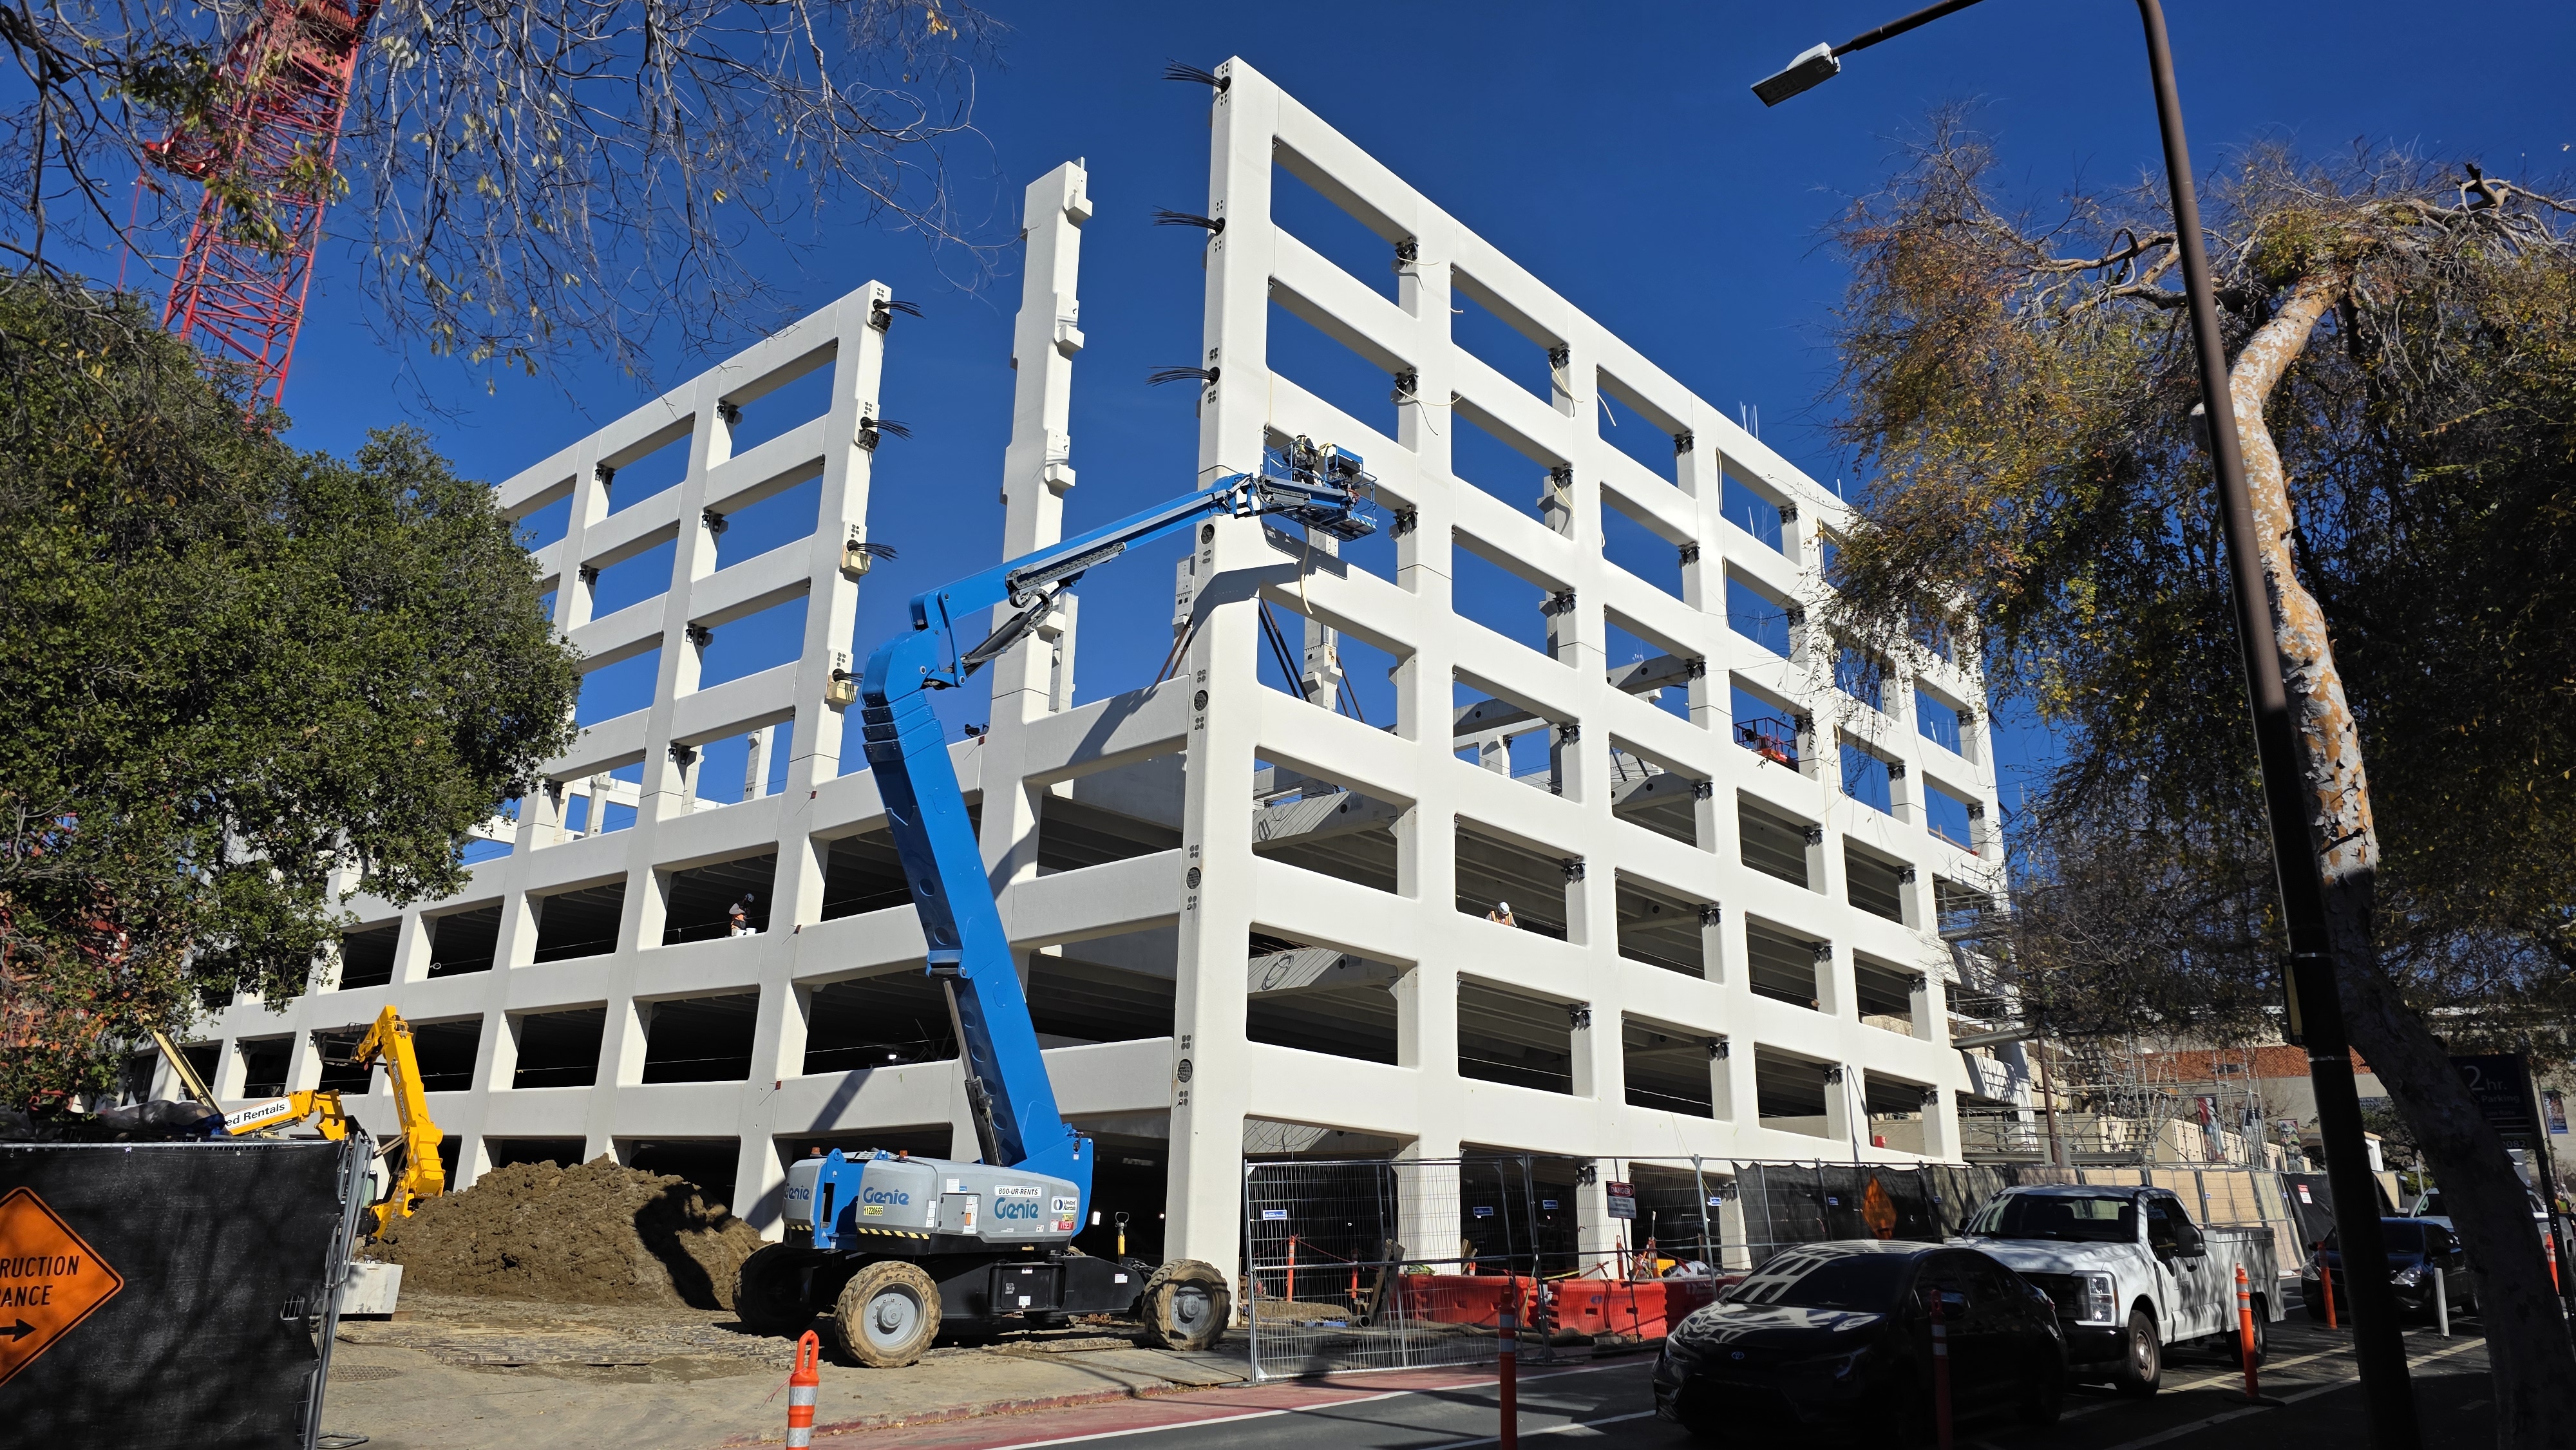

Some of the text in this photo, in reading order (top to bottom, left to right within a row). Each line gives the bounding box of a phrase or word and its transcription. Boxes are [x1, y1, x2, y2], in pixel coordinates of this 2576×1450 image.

[2464, 1065, 2507, 1091] 2 hr.
[2481, 1095, 2521, 1104] Parking
[243, 1103, 285, 1122] Rentals
[2502, 1139, 2527, 1148] 082
[863, 1187, 909, 1205] Genie
[1611, 1186, 1631, 1195] DANGER
[994, 1197, 1039, 1219] Genie
[0, 1256, 80, 1278] RUCTION
[0, 1285, 53, 1307] ANCE
